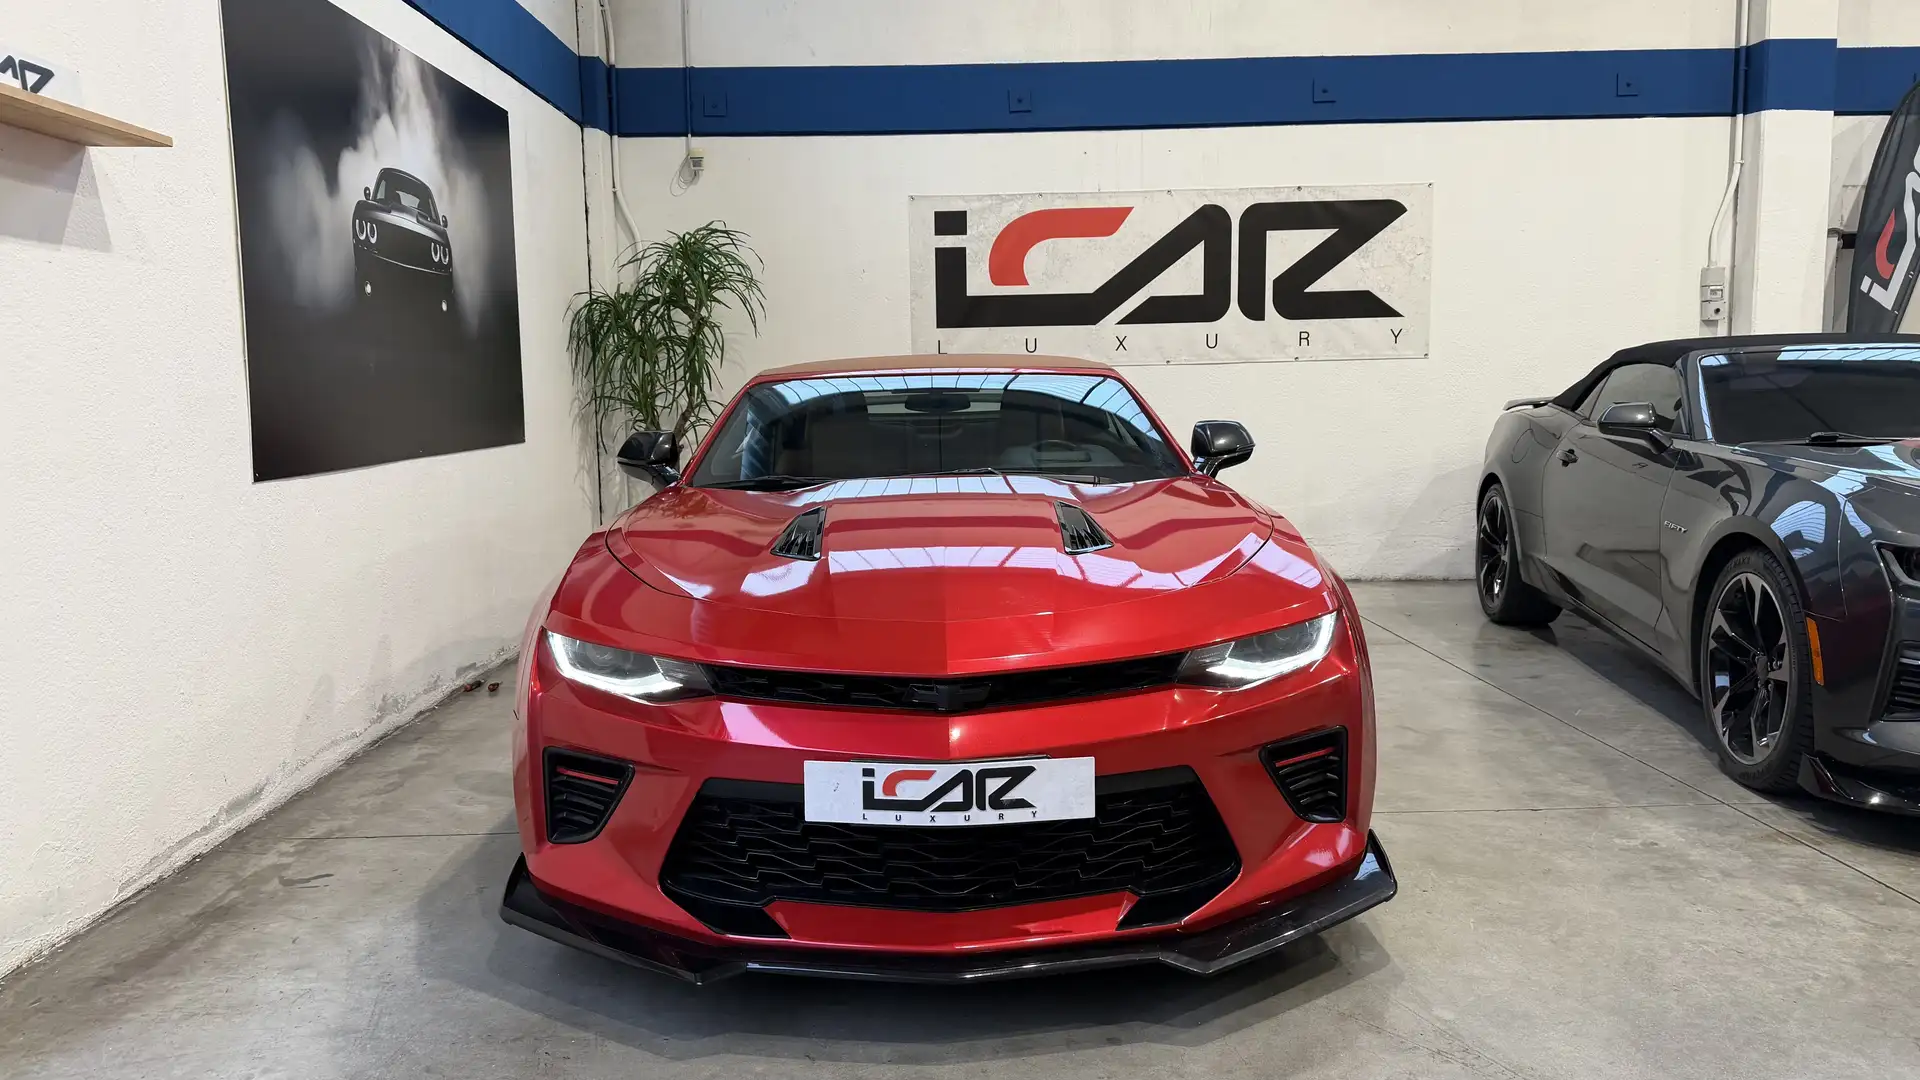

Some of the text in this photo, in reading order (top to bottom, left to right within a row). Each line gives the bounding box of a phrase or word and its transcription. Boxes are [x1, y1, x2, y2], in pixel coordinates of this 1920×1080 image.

[937, 328, 1404, 355] LUXURY
[1664, 520, 1688, 533] FIFTY
[862, 810, 1038, 823] LUXURY
